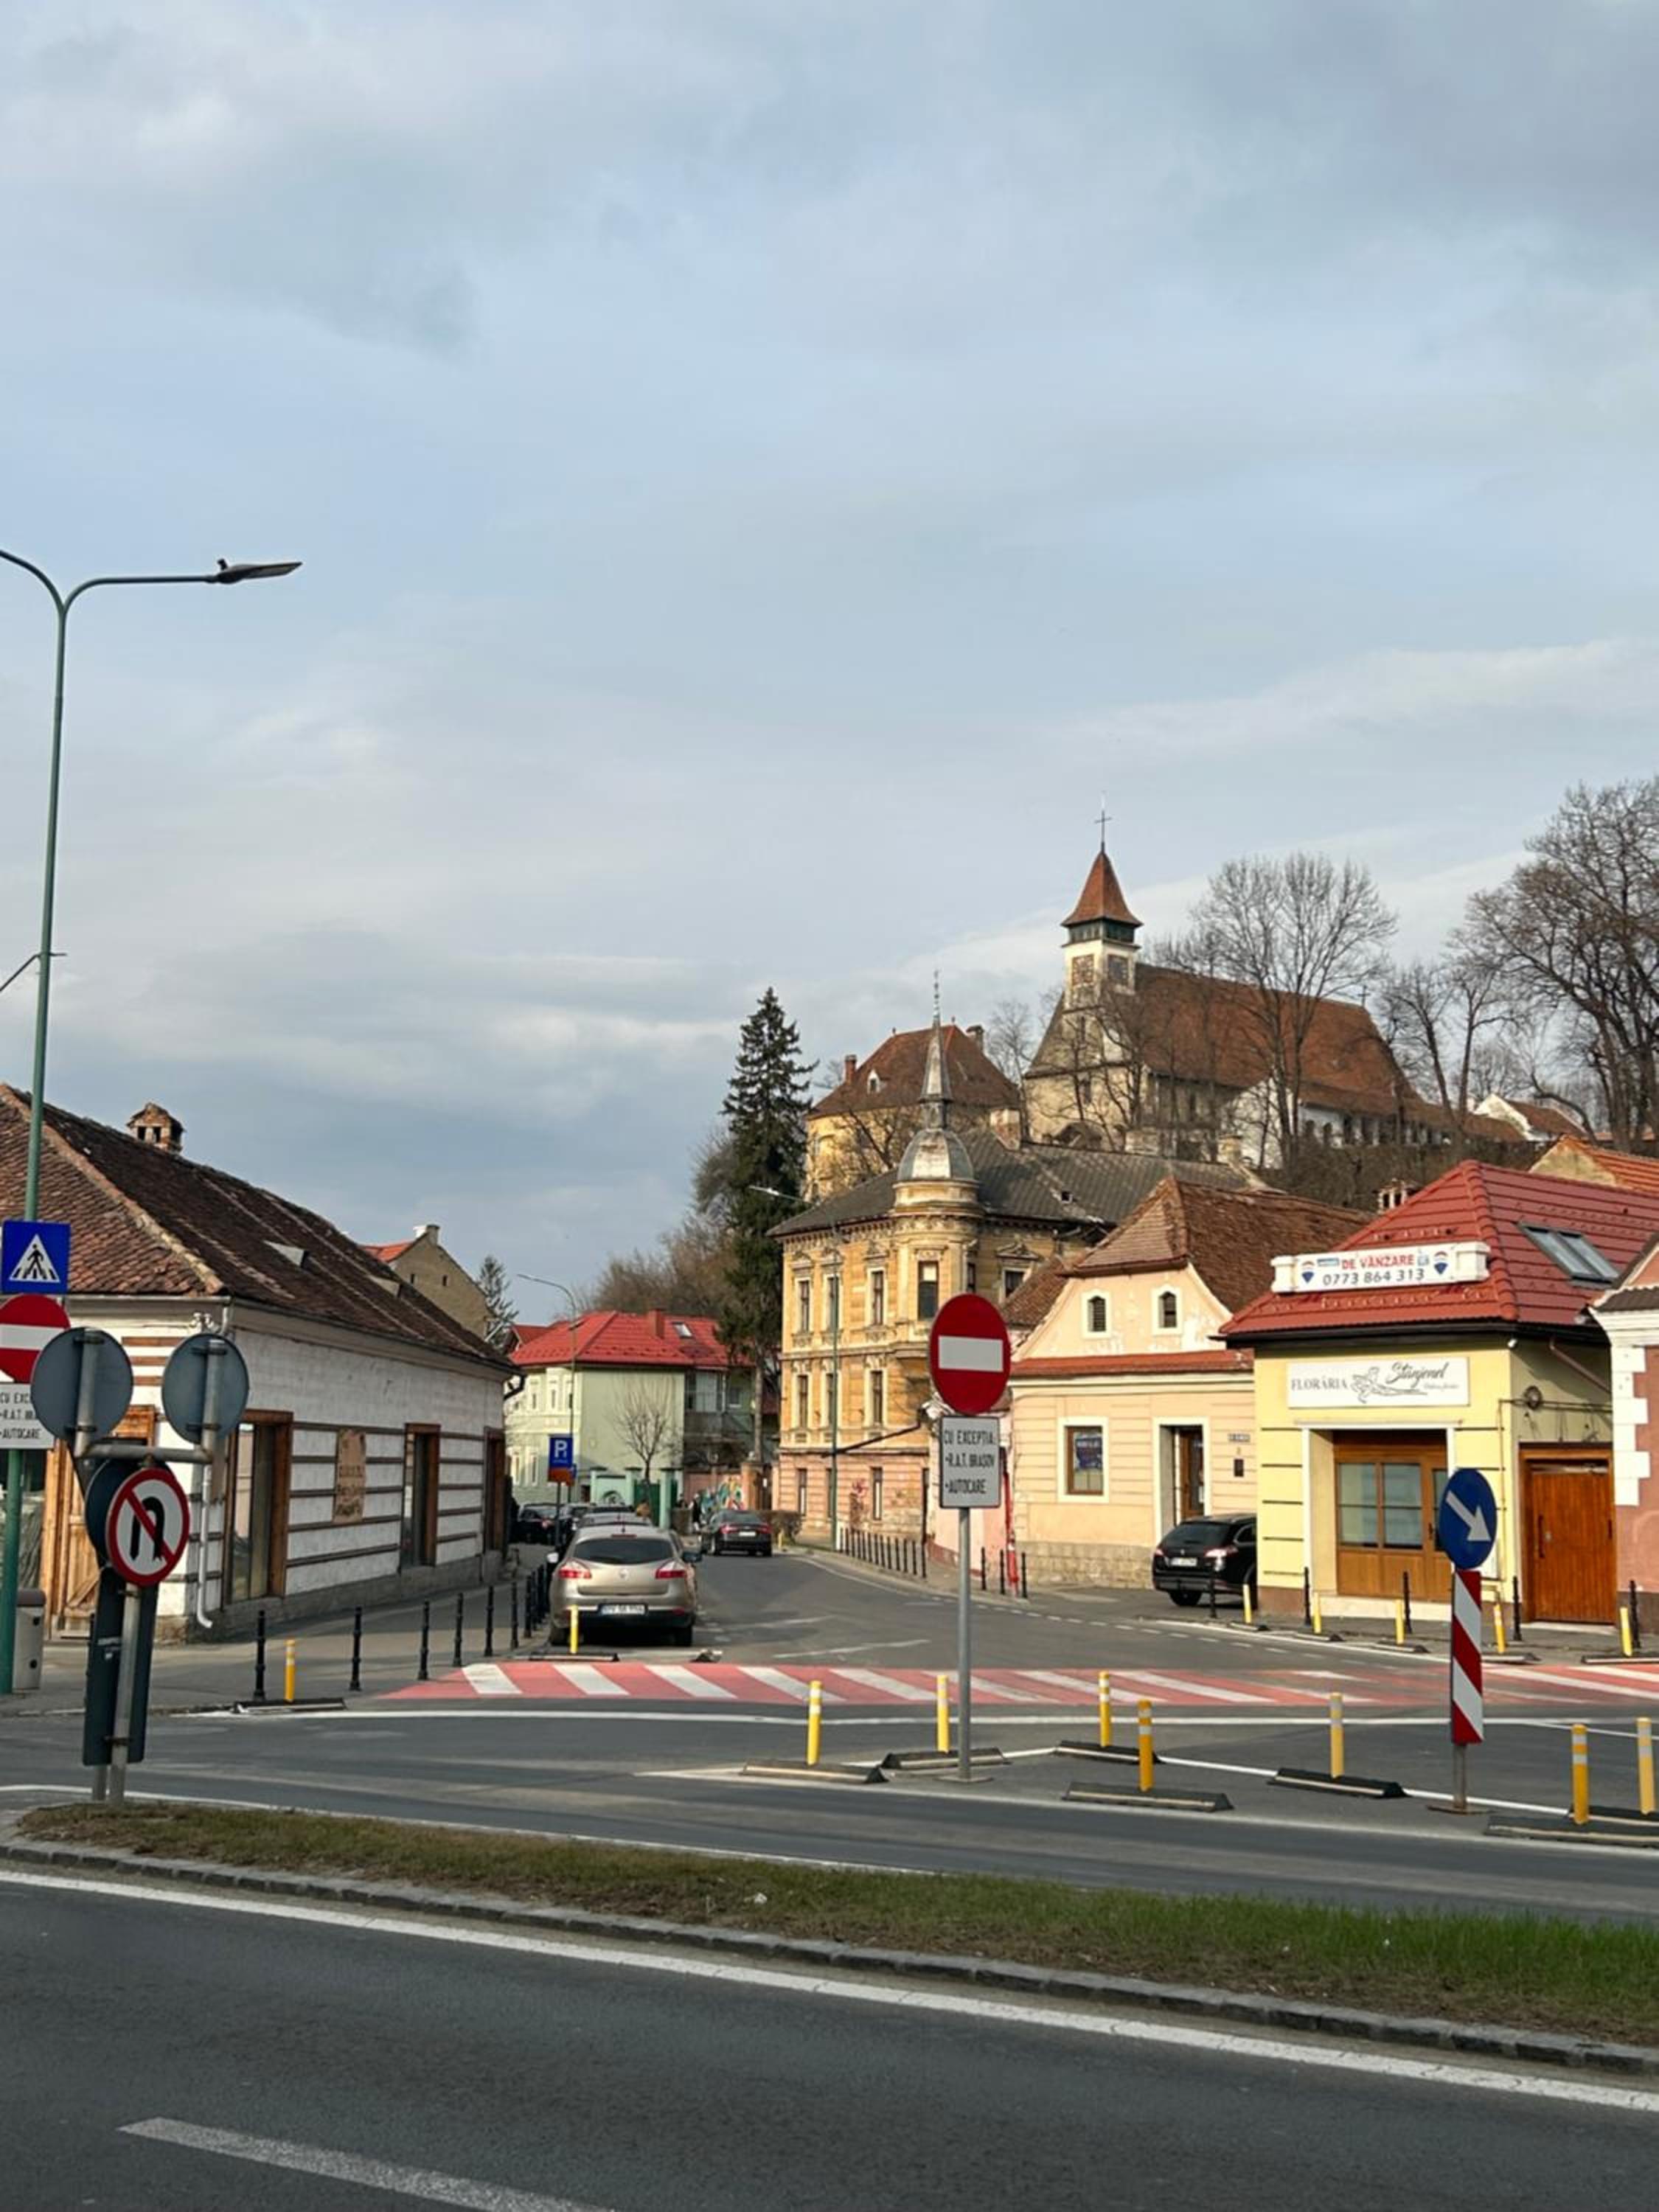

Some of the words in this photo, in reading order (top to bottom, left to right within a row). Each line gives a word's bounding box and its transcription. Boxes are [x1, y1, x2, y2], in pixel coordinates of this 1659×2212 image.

[1342, 1259, 1356, 1270] DE
[1323, 1273, 1359, 1286] 0773
[1363, 1270, 1391, 1283] 864
[1397, 1268, 1425, 1281] 313
[944, 1430, 953, 1444] CU
[554, 1439, 568, 1458] P
